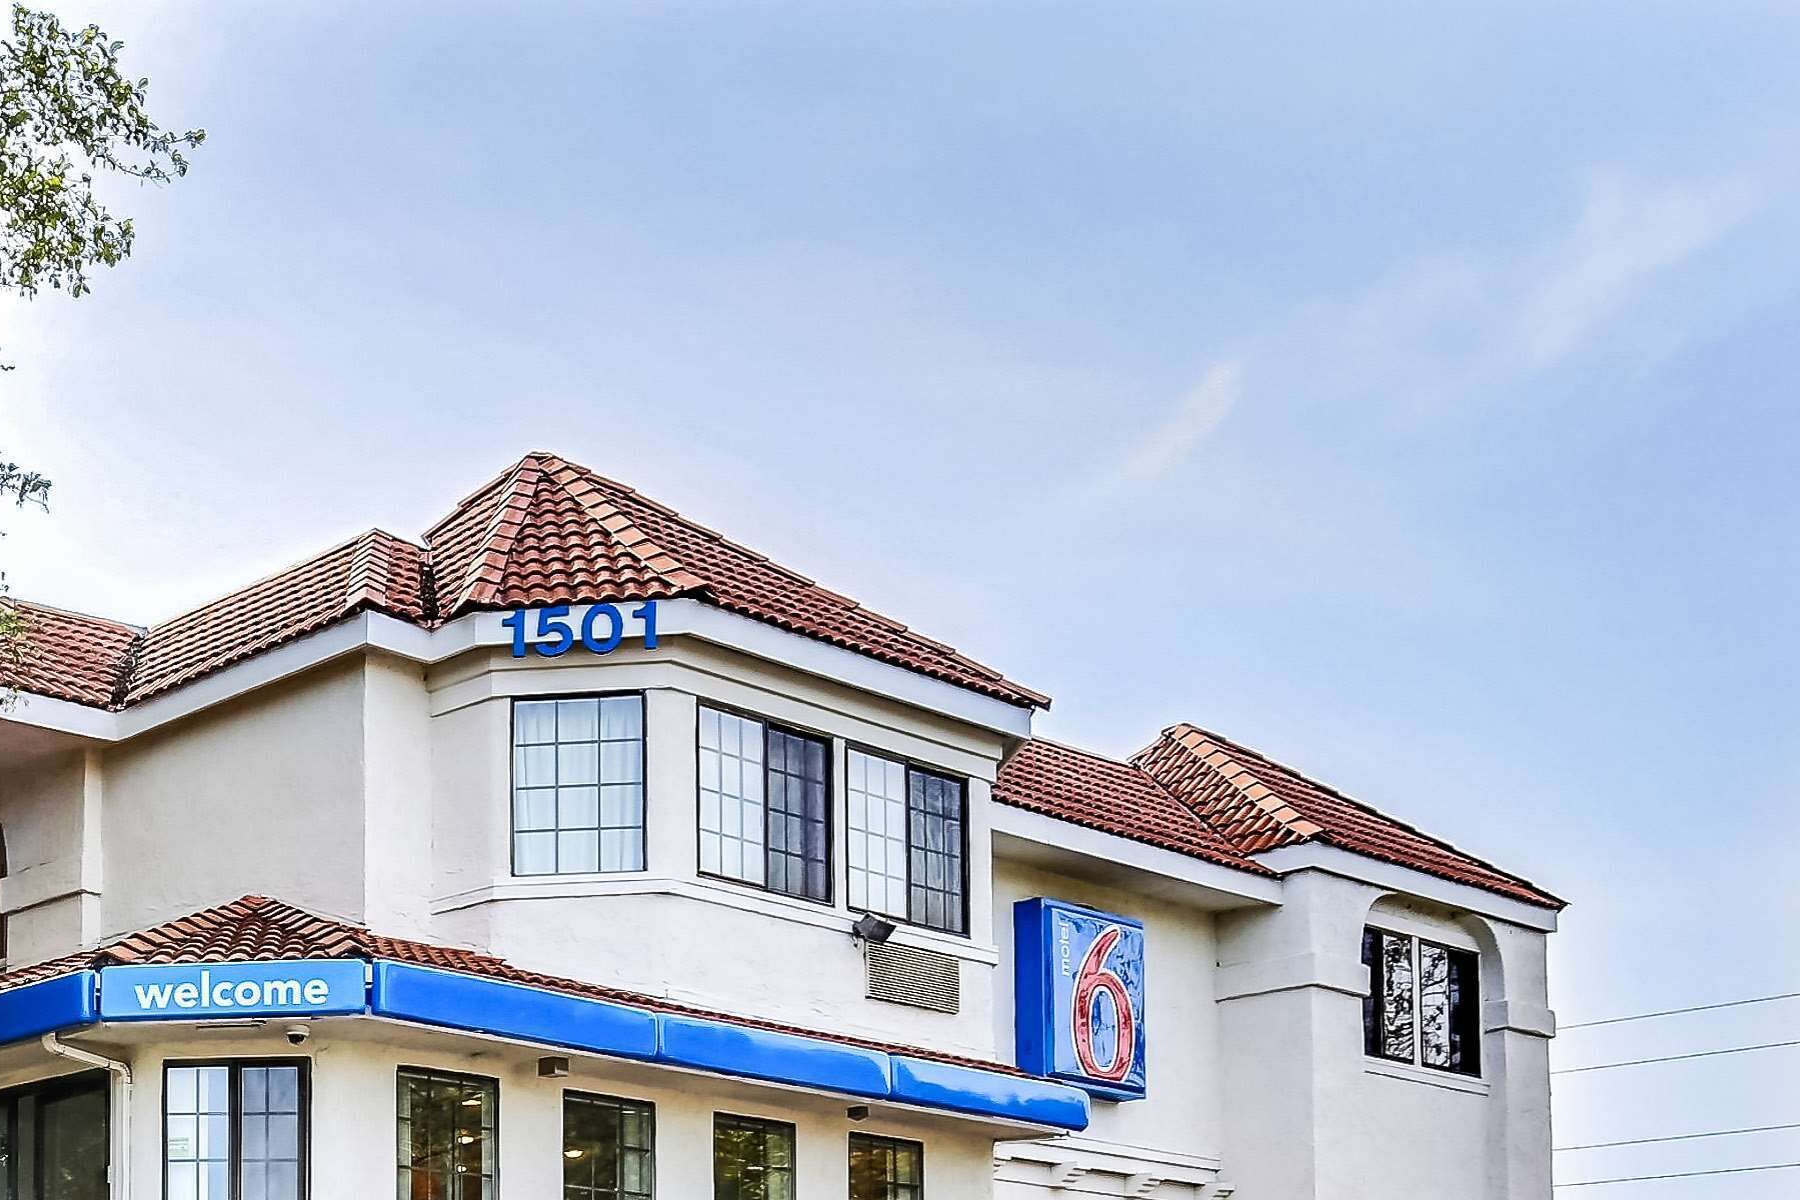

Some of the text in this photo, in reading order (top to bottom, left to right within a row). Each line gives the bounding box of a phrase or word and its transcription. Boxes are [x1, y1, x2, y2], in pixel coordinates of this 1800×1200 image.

[502, 600, 657, 658] 1501
[134, 970, 328, 1009] welcome
[1058, 922, 1136, 1082] motel 6
